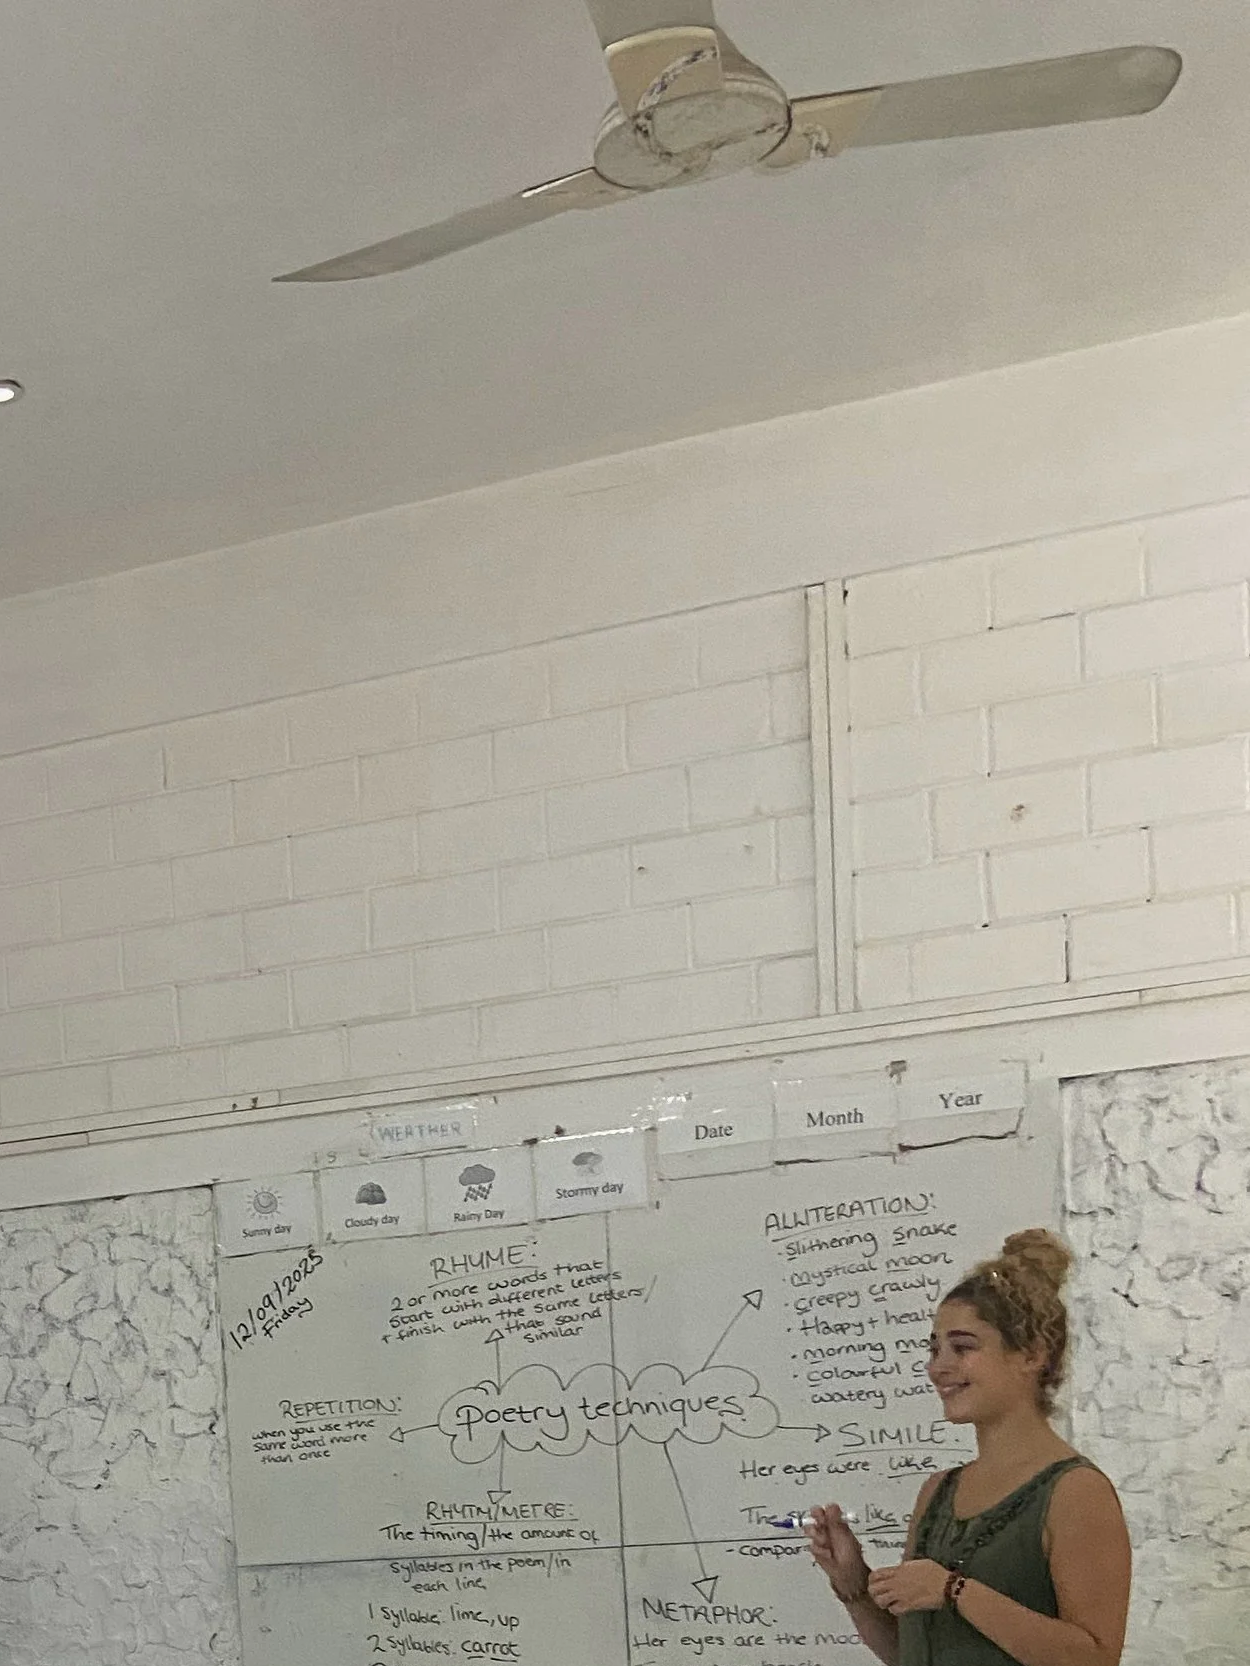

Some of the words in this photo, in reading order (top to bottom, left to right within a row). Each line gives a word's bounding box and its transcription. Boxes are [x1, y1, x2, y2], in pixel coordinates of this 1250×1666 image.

[939, 1091, 982, 1109] Year
[806, 1108, 864, 1128] Month
[694, 1124, 734, 1141] Date
[555, 1185, 600, 1200] Stormy
[602, 1181, 625, 1195] day
[345, 1217, 380, 1229] Cloudy
[382, 1213, 400, 1226] day
[453, 1209, 482, 1223] Rainy
[484, 1208, 505, 1221] Day
[764, 1192, 937, 1236] ALLITERATION:
[242, 1227, 272, 1239] Sunny
[274, 1224, 292, 1235] day
[390, 1296, 404, 1312] 2
[407, 1294, 426, 1307] or
[432, 1284, 479, 1301] more
[488, 1270, 548, 1291] words
[553, 1259, 604, 1275] that
[441, 1299, 483, 1314] with
[488, 1284, 565, 1306] different
[570, 1270, 622, 1289] letters
[230, 1249, 324, 1350] 12/09/2025
[261, 1297, 314, 1338] Friday
[396, 1322, 446, 1341] finish
[452, 1315, 491, 1330] with
[495, 1307, 526, 1320] the
[533, 1298, 580, 1314] same
[504, 1319, 545, 1335] that
[554, 1307, 602, 1326] sound
[800, 1316, 865, 1336] Happy
[884, 1309, 936, 1326] healt
[523, 1325, 585, 1344] similar
[894, 1384, 936, 1398] wat
[279, 1396, 402, 1419] REPETITION:
[252, 1429, 286, 1441] when
[289, 1426, 316, 1442] you
[318, 1422, 342, 1433] use
[345, 1418, 377, 1430] the
[455, 1403, 569, 1442] Poetry
[253, 1440, 287, 1453] same
[290, 1435, 326, 1450] word
[330, 1432, 368, 1444] more
[260, 1453, 294, 1465] than
[298, 1449, 332, 1461] once
[739, 1459, 776, 1480] Her
[782, 1462, 819, 1486] eyes
[826, 1458, 870, 1474] were
[888, 1454, 937, 1470] like
[740, 1504, 778, 1525] The
[865, 1503, 898, 1524] like
[379, 1523, 414, 1542] The
[521, 1527, 576, 1540] amount
[580, 1529, 600, 1546] of
[458, 1560, 474, 1572] in
[478, 1559, 503, 1571] the
[411, 1580, 449, 1593] each
[368, 1602, 374, 1620] 1
[497, 1614, 520, 1632] up
[367, 1634, 386, 1653] 2
[461, 1639, 521, 1657] carrot
[632, 1632, 668, 1649] Her
[680, 1635, 726, 1655] eyes
[733, 1634, 765, 1647] are
[773, 1631, 807, 1646] the
[815, 1633, 861, 1646] moo
